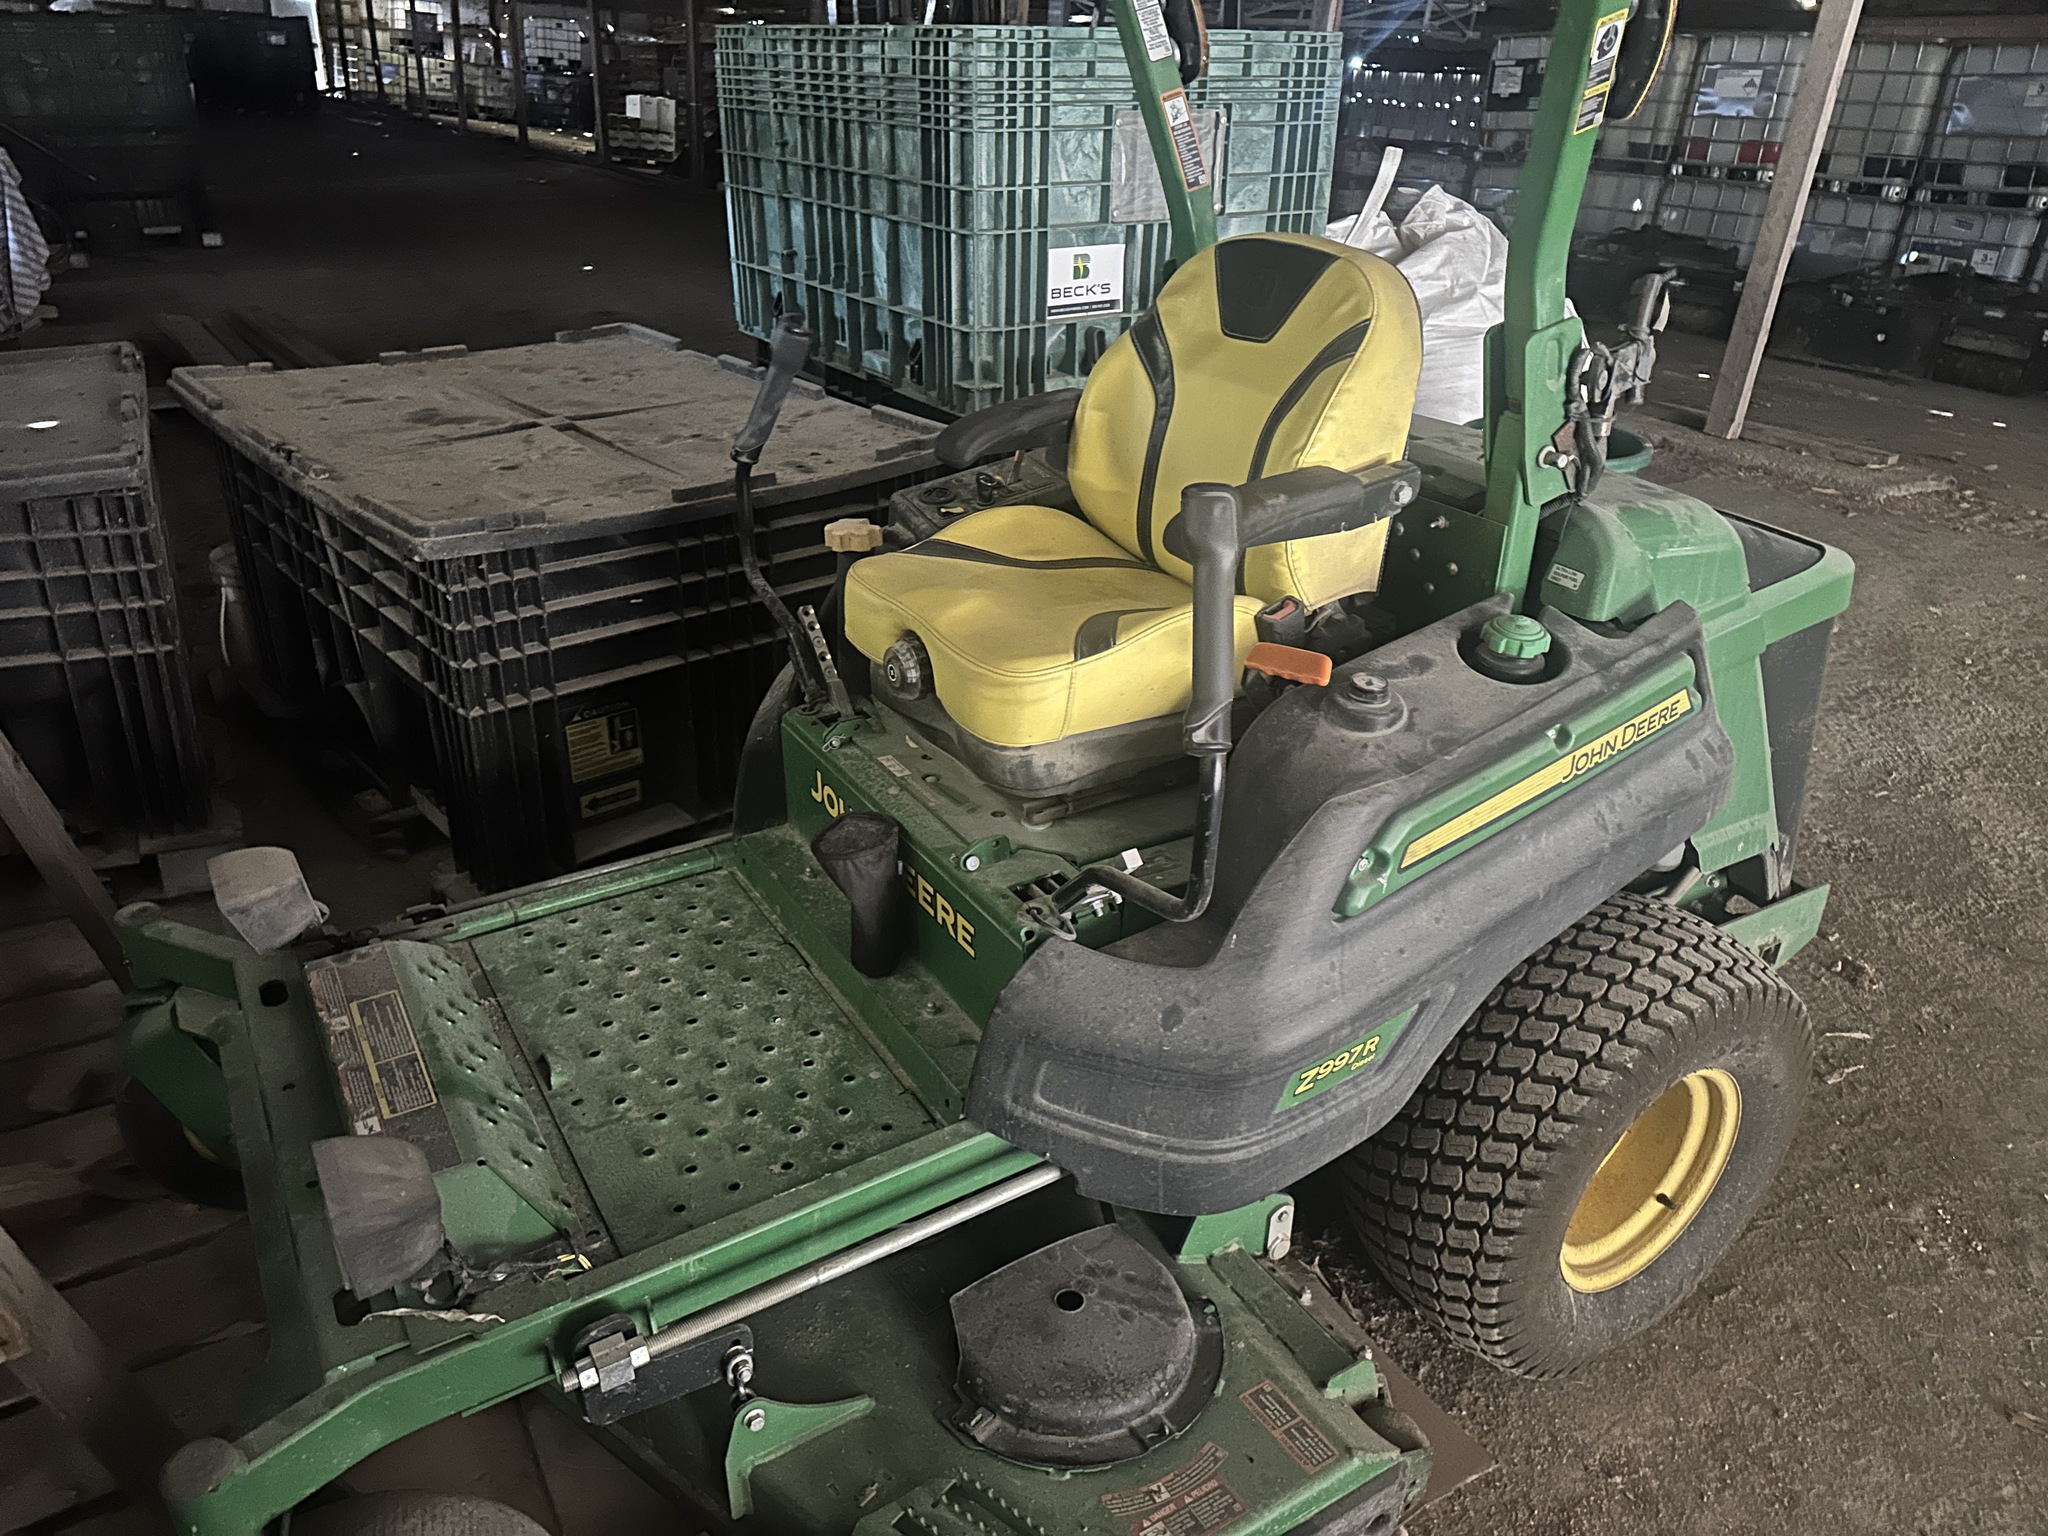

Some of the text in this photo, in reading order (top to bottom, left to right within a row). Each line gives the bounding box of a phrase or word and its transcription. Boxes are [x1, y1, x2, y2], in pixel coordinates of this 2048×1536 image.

[1051, 283, 1111, 299] BECK'S
[1562, 700, 1681, 781] JOHN DEERE
[1293, 1035, 1381, 1096] Z997R
